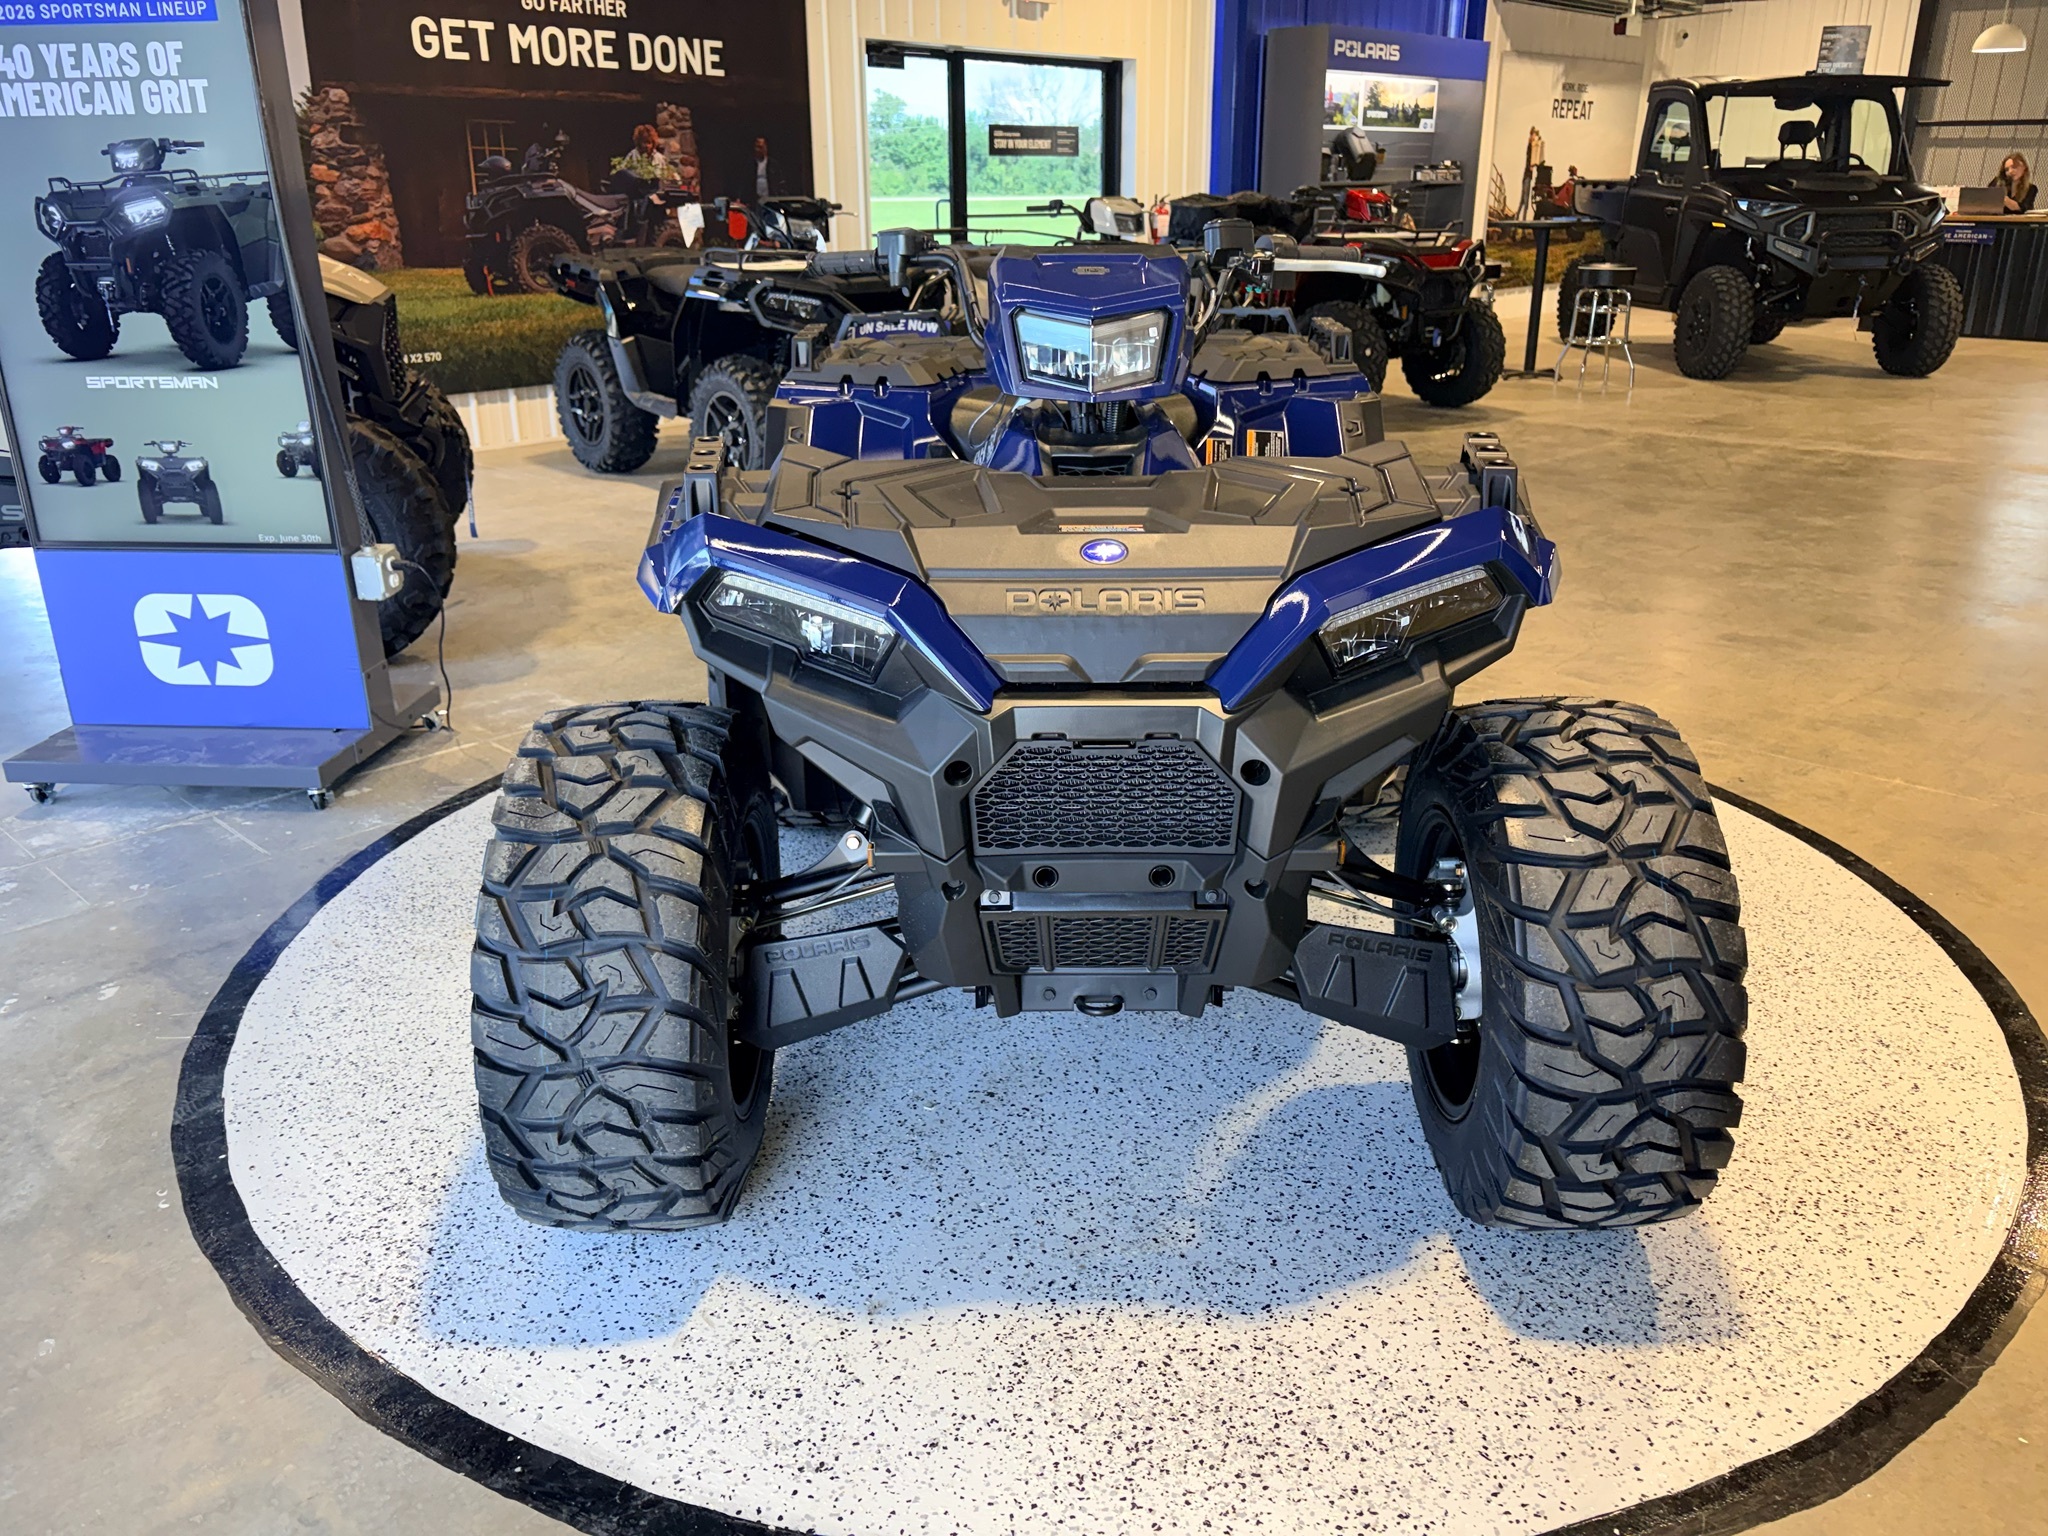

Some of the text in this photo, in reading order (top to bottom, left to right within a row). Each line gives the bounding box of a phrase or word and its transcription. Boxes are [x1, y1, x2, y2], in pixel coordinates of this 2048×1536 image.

[40, 3, 142, 19] SPORTSMAN
[147, 1, 207, 16] LINEUP
[521, 0, 627, 18] GO FARTHER
[410, 16, 725, 77] GET MORE DONE
[1334, 39, 1400, 61] POLARIS
[0, 41, 183, 79] 40 YEARS OF
[0, 79, 208, 117] MERICAN GRIT
[1551, 98, 1593, 120] REPEAT
[875, 319, 907, 333] SALE
[907, 319, 938, 334] NOW
[409, 353, 423, 363] X2
[424, 351, 442, 362] 570
[85, 376, 219, 389] SPORTSMAN
[258, 534, 321, 543] Exp. June 30th
[1006, 588, 1206, 616] POLARIS
[764, 934, 871, 964] POLARIS
[1328, 932, 1433, 962] POLARIS
